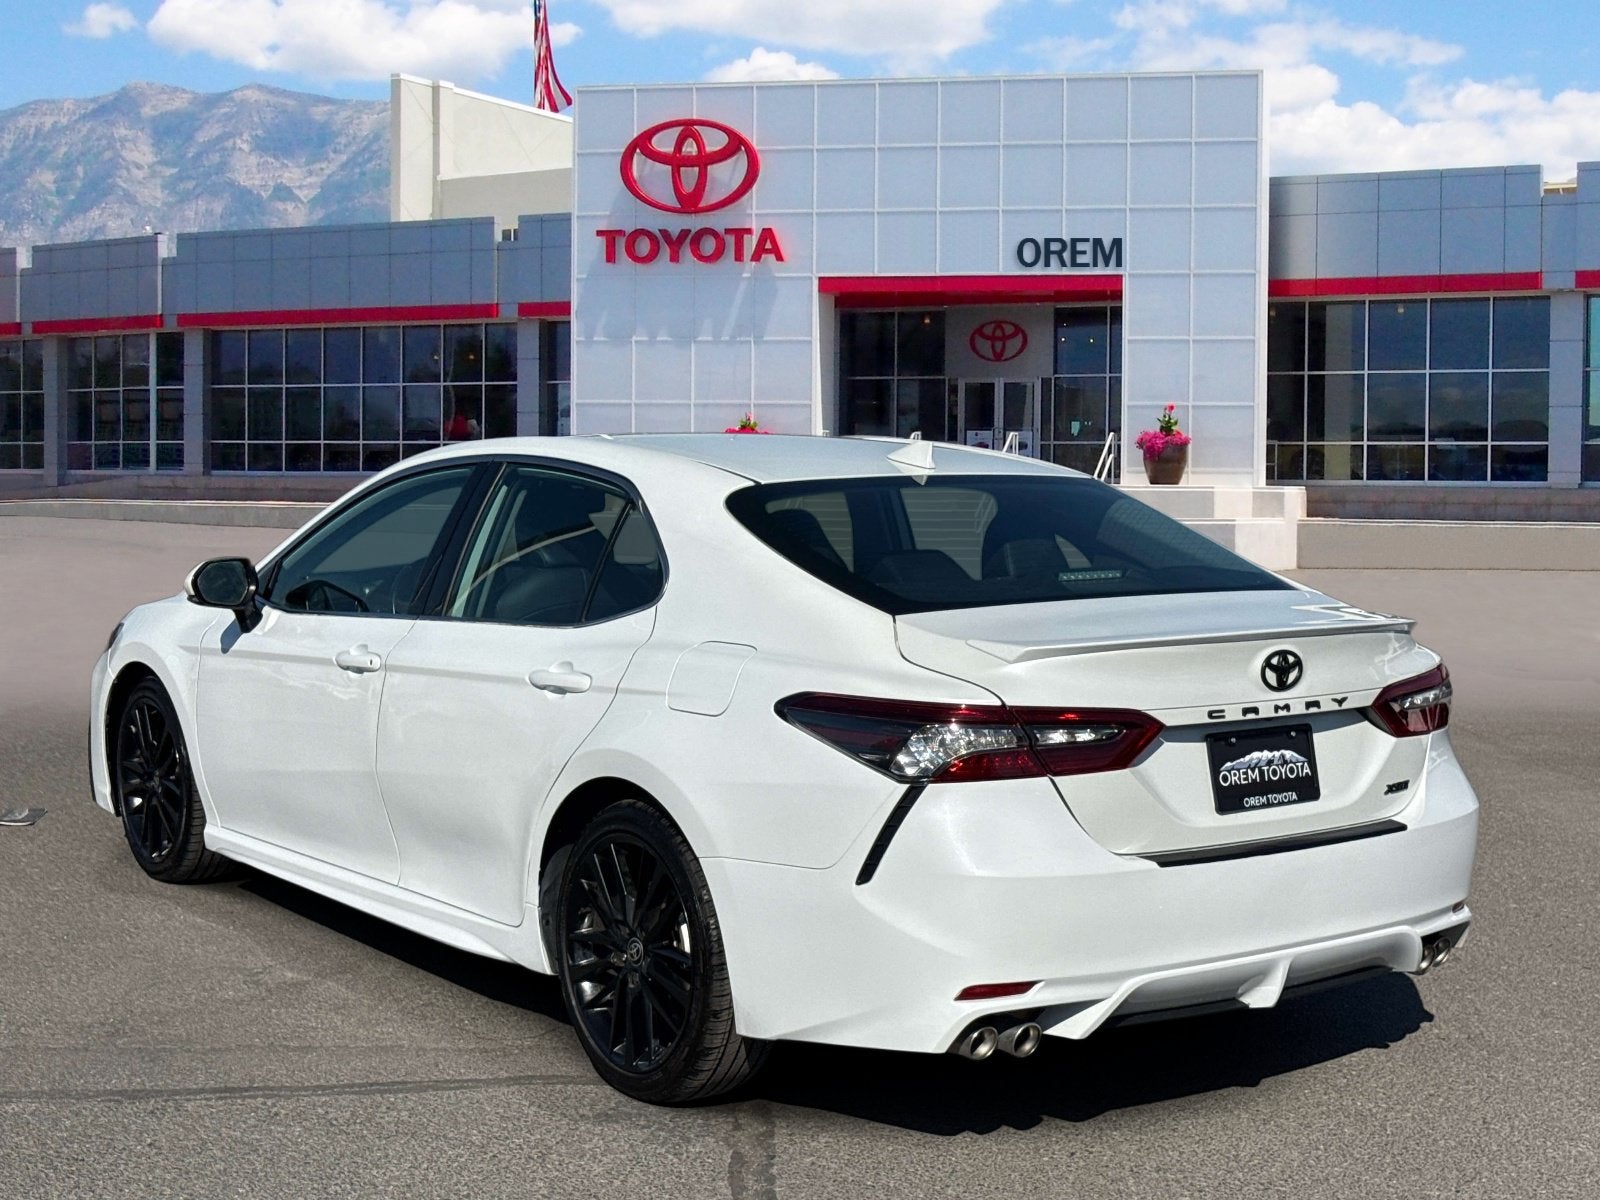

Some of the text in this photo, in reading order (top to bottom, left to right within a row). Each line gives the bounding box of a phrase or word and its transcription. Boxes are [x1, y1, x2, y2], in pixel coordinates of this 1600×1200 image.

[596, 227, 784, 264] TOYOTA
[1017, 237, 1123, 268] OREM
[1207, 696, 1348, 720] CAMRY
[1219, 762, 1312, 787] OREM TOYOTA
[1243, 791, 1299, 808] OREM TOYOTA
